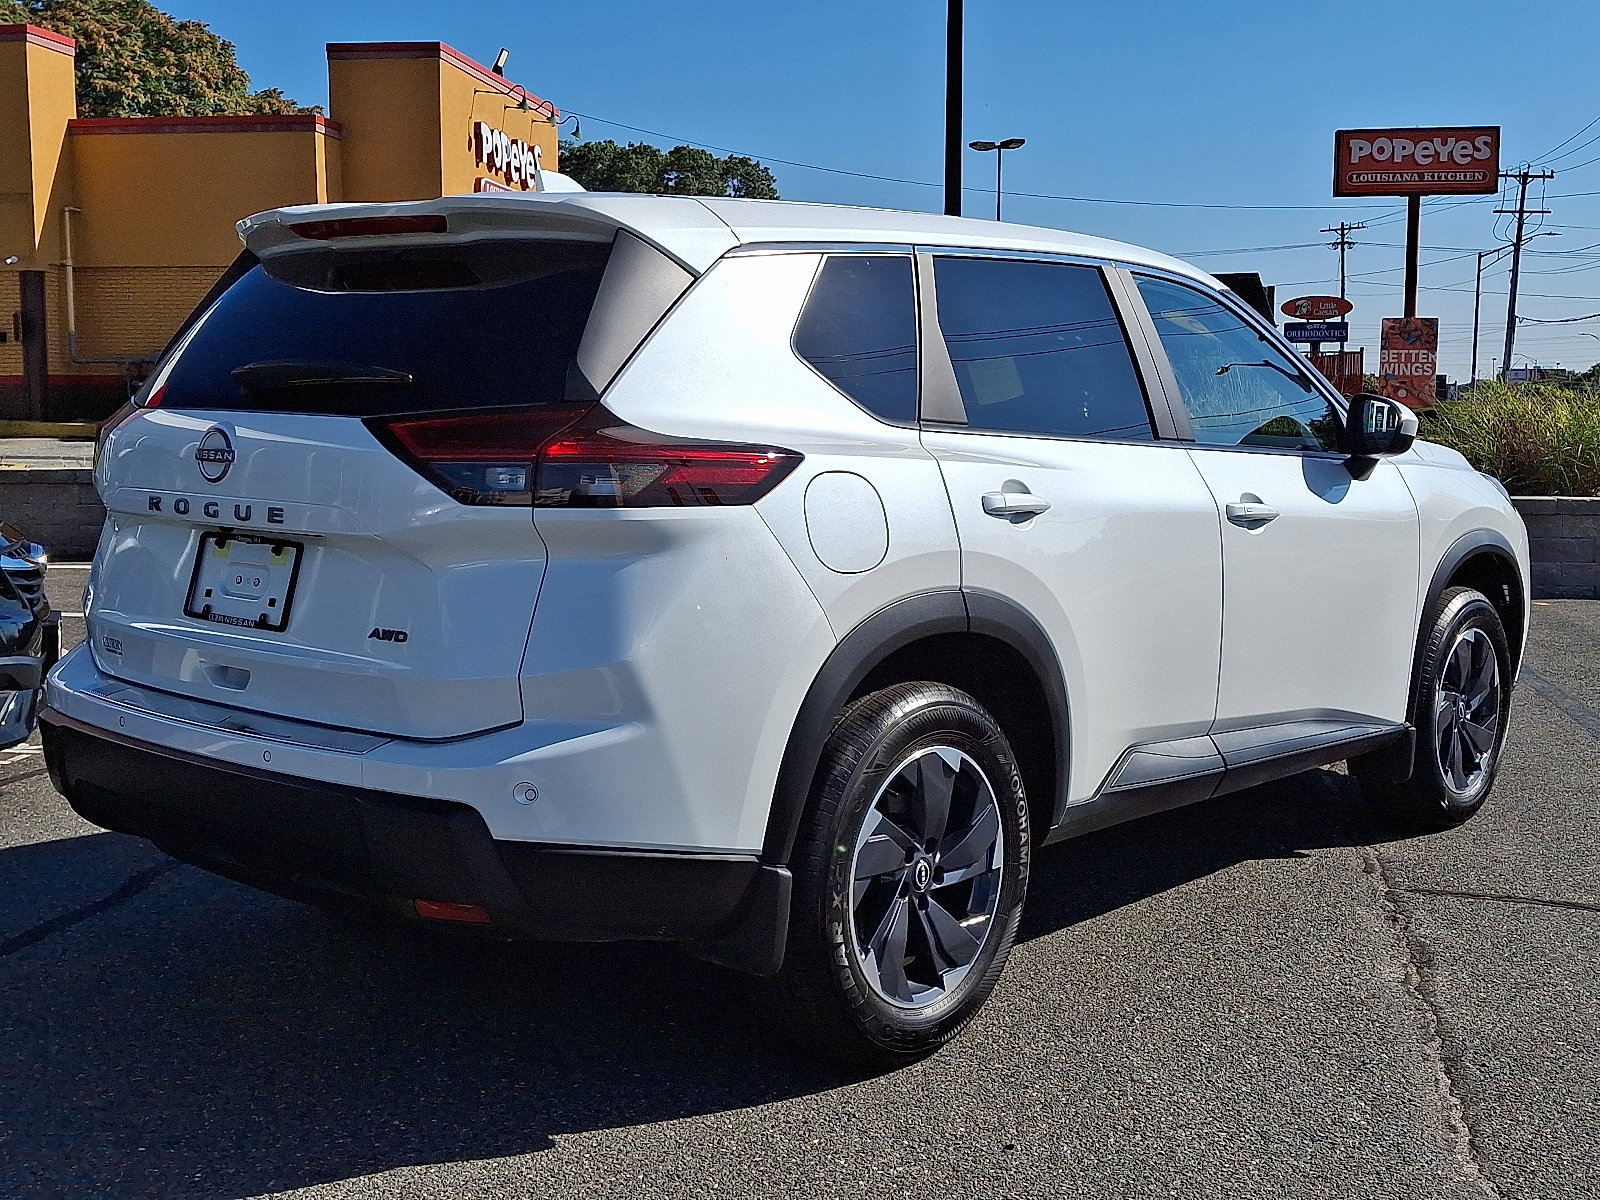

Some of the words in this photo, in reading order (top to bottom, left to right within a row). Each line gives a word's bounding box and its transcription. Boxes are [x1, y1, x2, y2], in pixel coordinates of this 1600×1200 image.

[1352, 172, 1419, 183] LOUISIANA
[1422, 171, 1484, 182] KITCHEN
[1319, 301, 1337, 310] Little
[1286, 329, 1347, 338] ORTHODONTICS
[1381, 363, 1433, 376] WINGS
[196, 450, 233, 461] NISSAN
[148, 495, 285, 524] ROGUE
[224, 616, 255, 628] NISSAN
[367, 627, 409, 643] AWD
[1010, 763, 1028, 879] YOKOHAMA
